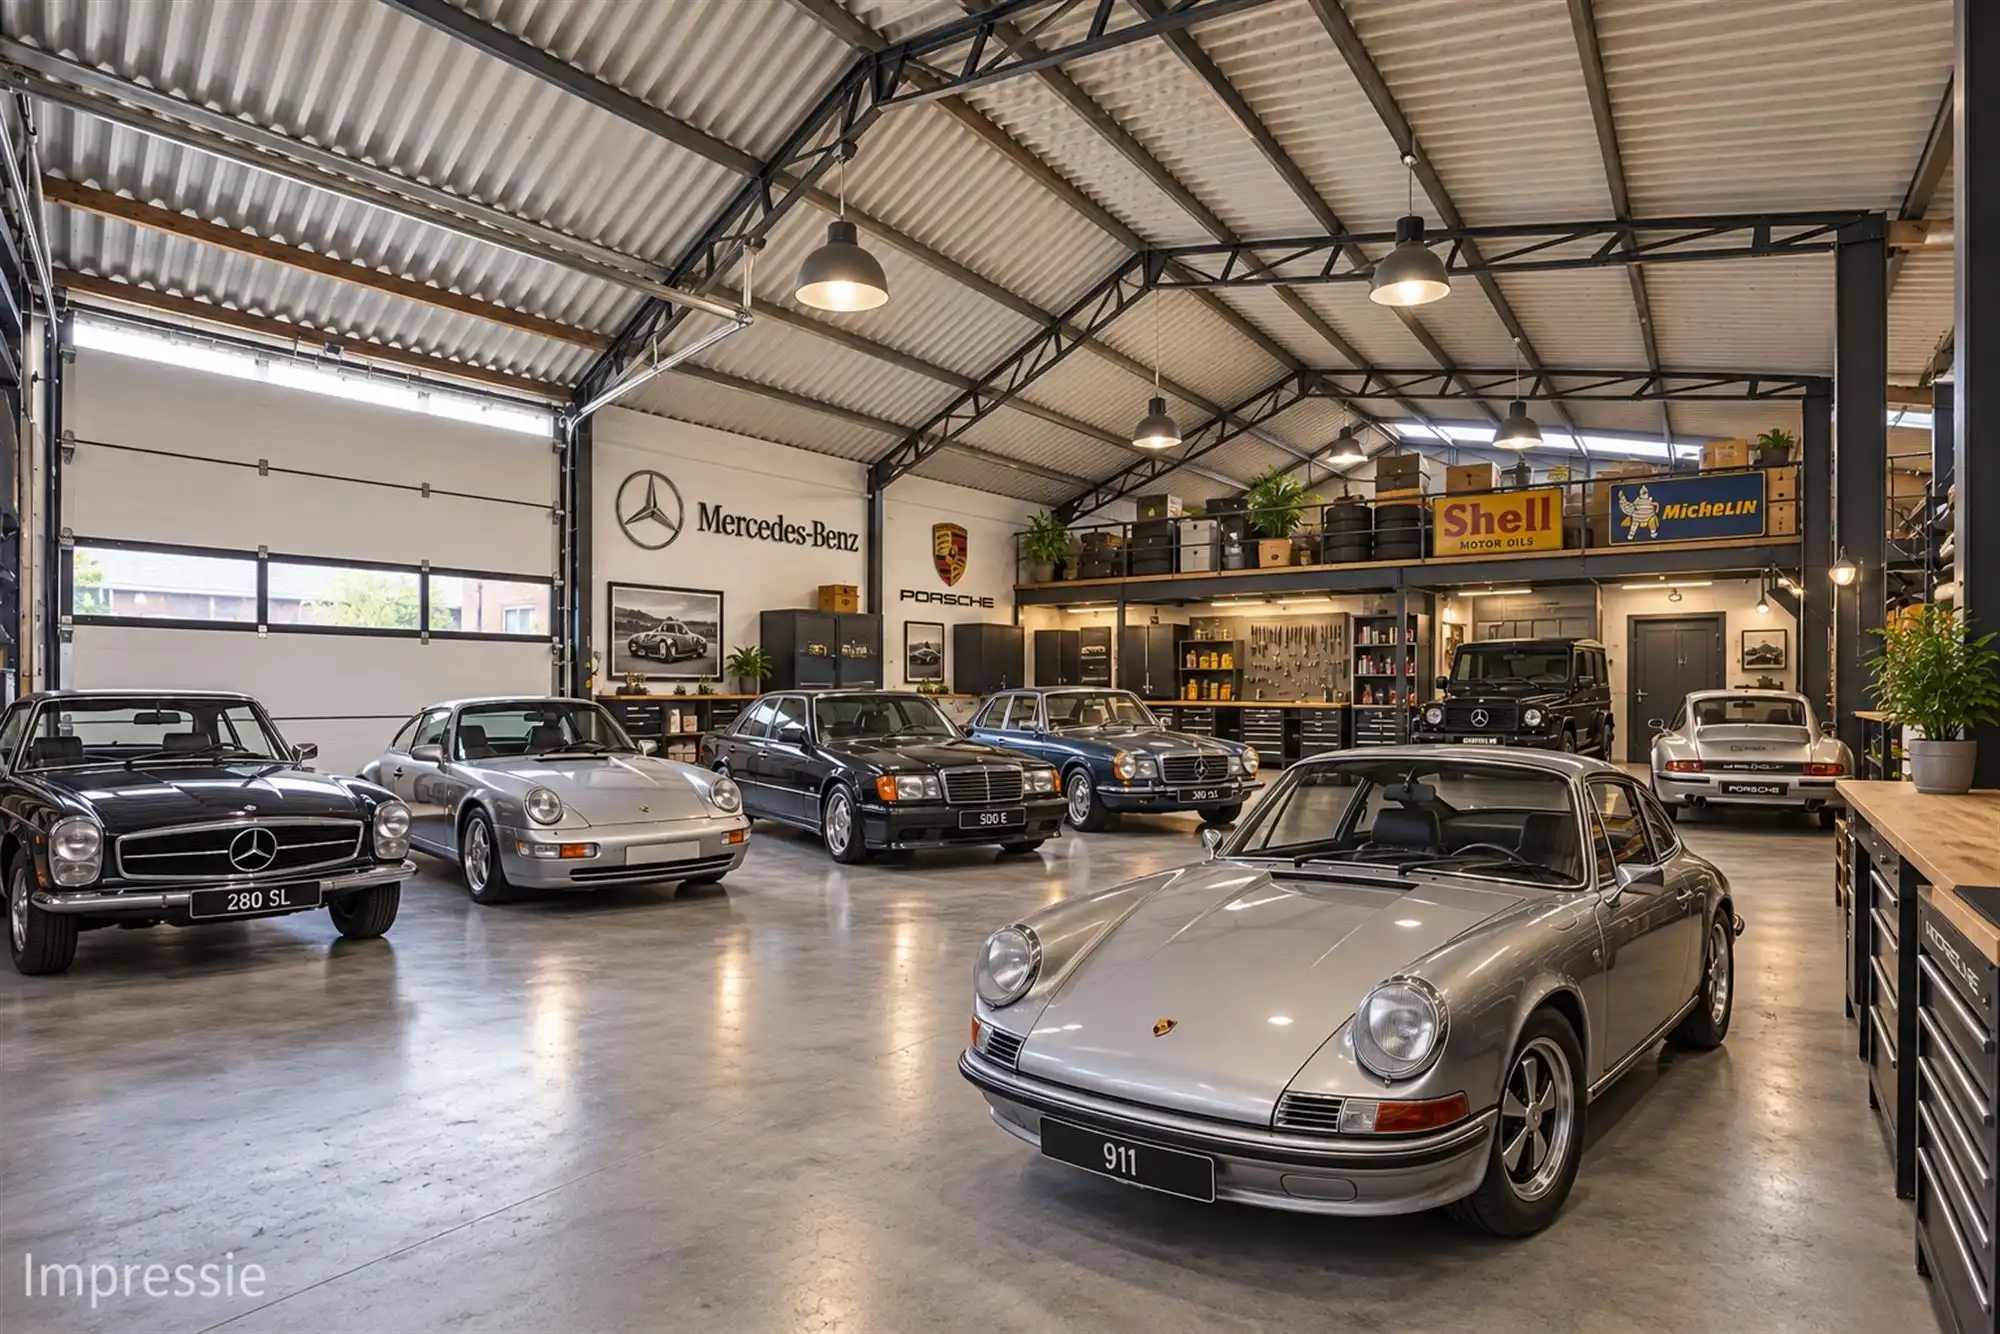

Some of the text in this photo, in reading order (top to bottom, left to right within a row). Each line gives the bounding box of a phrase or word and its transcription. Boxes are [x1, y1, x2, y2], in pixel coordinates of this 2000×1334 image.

[697, 501, 859, 552] Mercedes-Benz
[1443, 496, 1552, 538] Shell
[1459, 537, 1534, 550] MOTOR OILS
[900, 589, 994, 609] PORSCHE
[1000, 812, 1008, 824] E
[227, 888, 291, 911] 280 SL
[1103, 1142, 1137, 1177] 911
